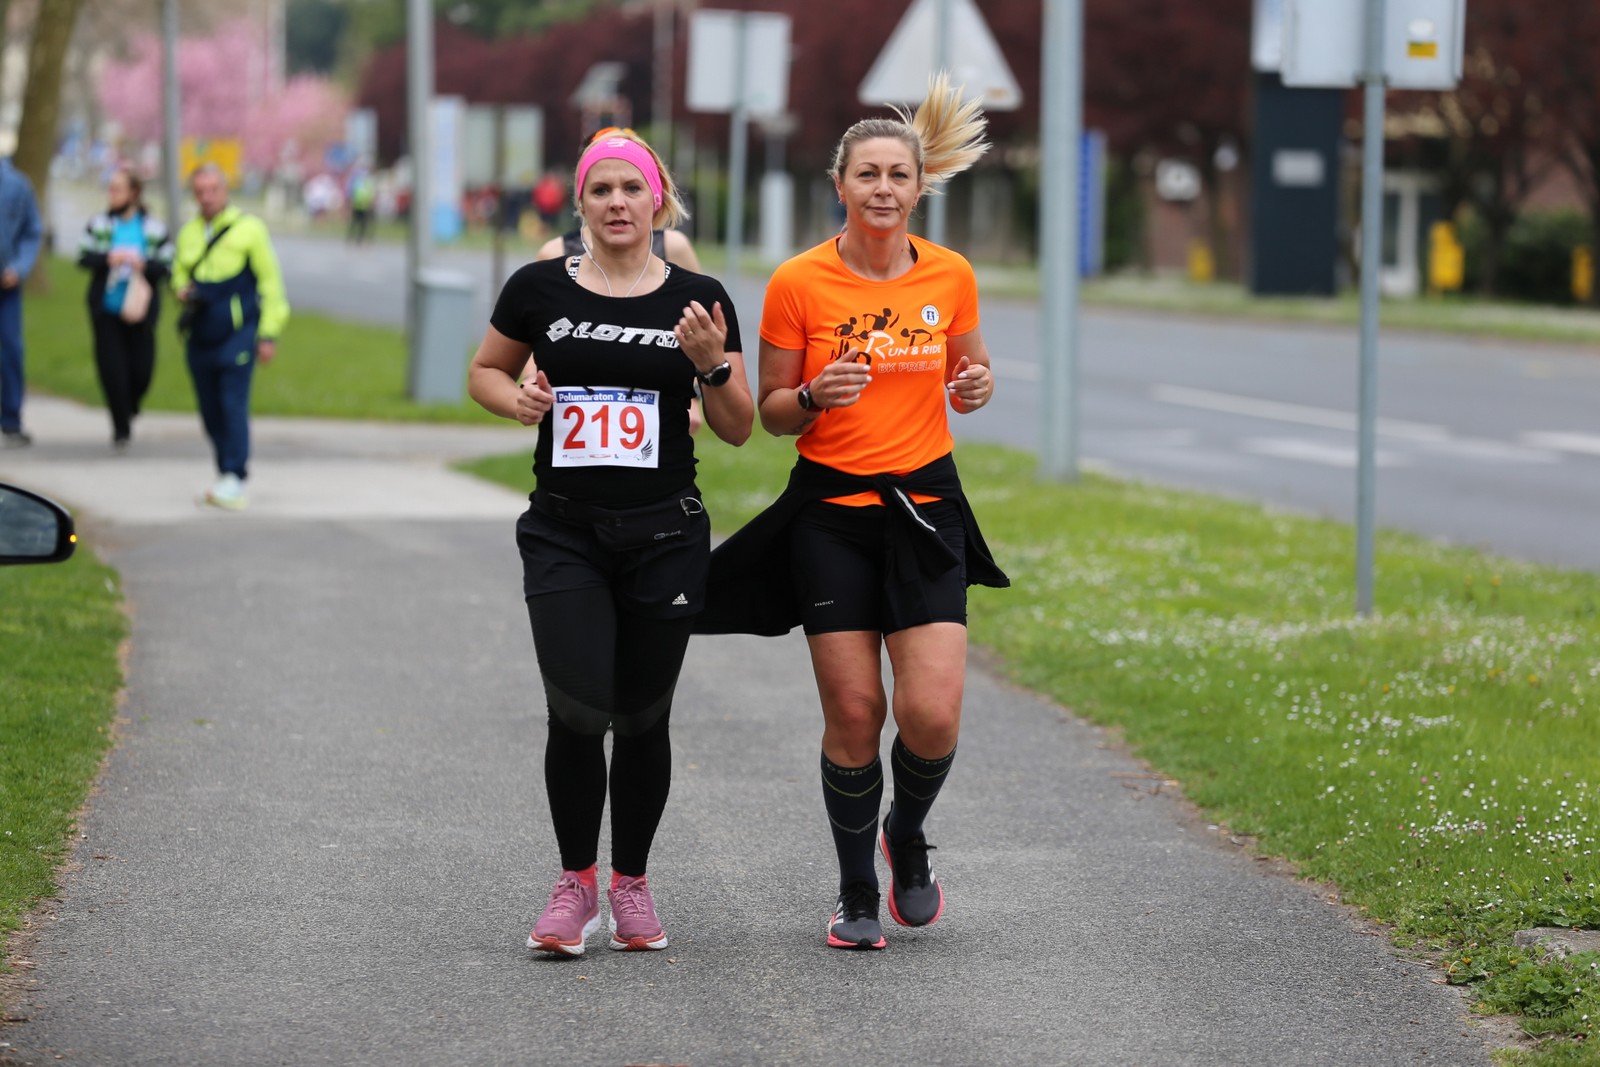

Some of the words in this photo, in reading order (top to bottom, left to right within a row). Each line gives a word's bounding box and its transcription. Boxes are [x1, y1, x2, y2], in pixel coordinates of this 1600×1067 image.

[911, 346, 919, 355] &
[922, 344, 942, 355] RIDE
[877, 362, 897, 374] BK
[558, 392, 614, 402] Polumaraton
[562, 404, 645, 450] 219
